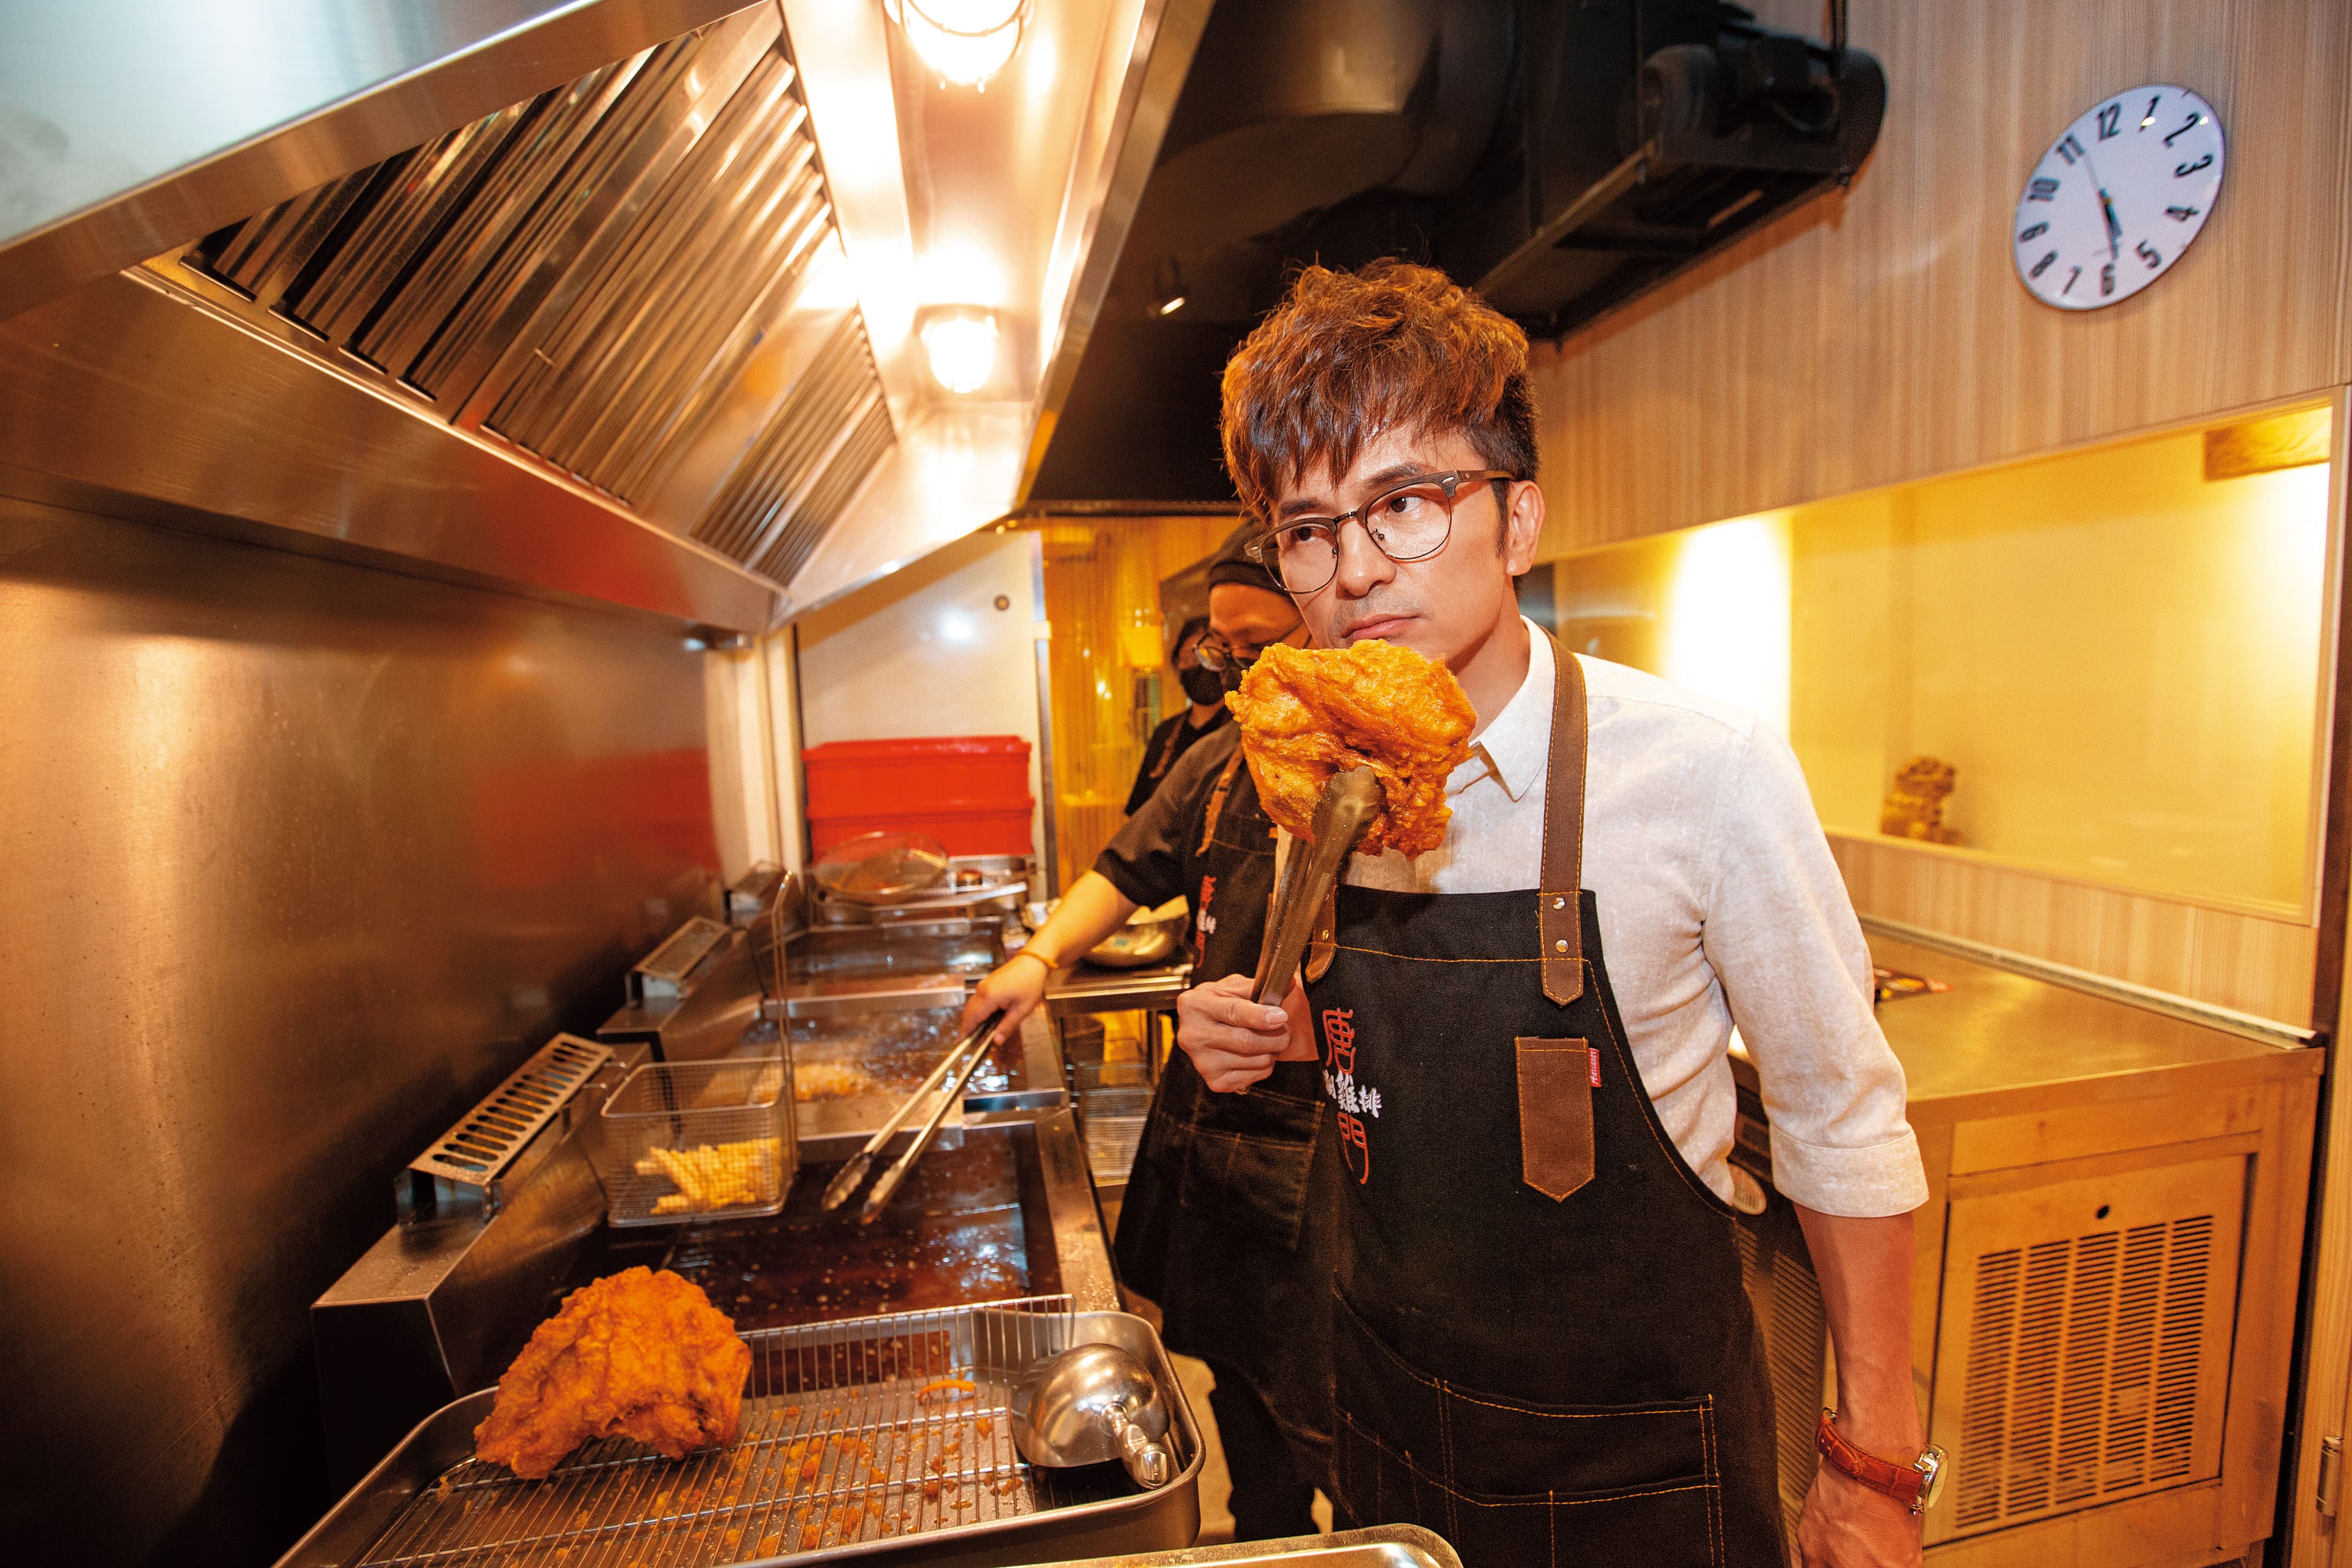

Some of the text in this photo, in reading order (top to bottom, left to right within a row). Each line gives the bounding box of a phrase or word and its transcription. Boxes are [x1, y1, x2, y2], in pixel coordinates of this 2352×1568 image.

[2097, 102, 2121, 142] 12
[2139, 94, 2160, 132] 1
[2162, 111, 2201, 148] 2
[2056, 134, 2084, 165] 11
[2174, 153, 2213, 178] 3
[2028, 177, 2060, 202] 10
[2165, 205, 2199, 222] 4
[2019, 222, 2049, 243] 9
[2029, 250, 2058, 279] 8
[2136, 239, 2162, 270] 5
[2062, 265, 2082, 295] 7
[2099, 262, 2116, 296] 6
